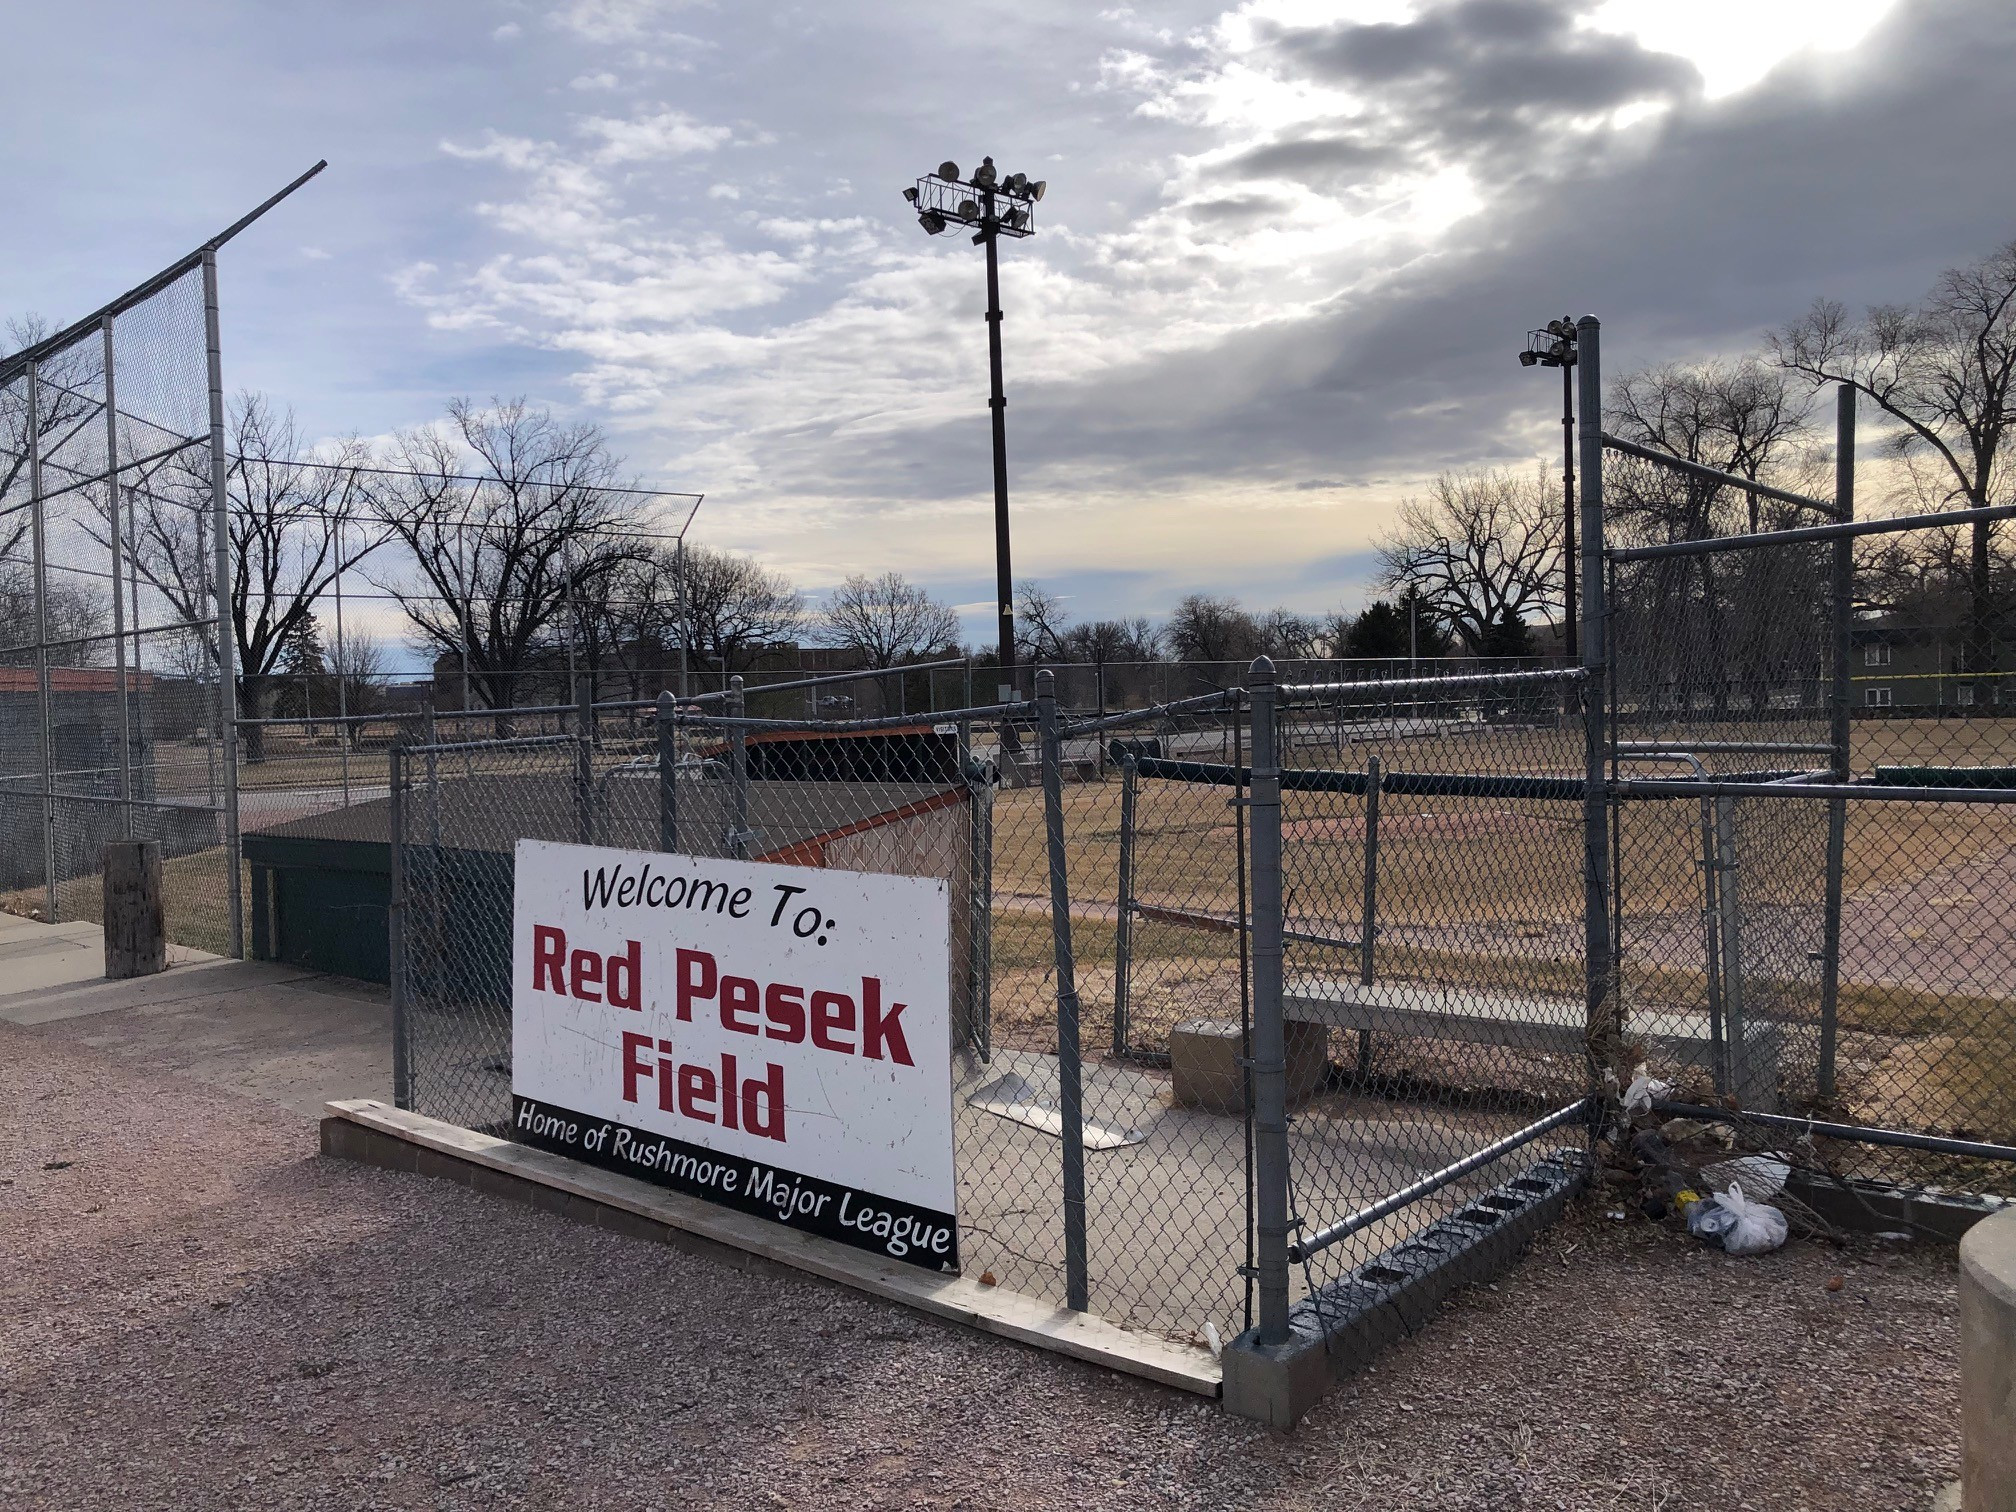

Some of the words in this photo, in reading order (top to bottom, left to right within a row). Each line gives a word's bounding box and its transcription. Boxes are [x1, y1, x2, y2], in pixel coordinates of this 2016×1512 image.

[583, 863, 752, 919] Welcome
[770, 884, 836, 946] To:
[532, 924, 643, 1012] Red
[675, 947, 916, 1067] Pesek
[622, 1030, 787, 1143] Field
[517, 1101, 578, 1144] Home
[584, 1124, 612, 1152] of
[613, 1128, 738, 1192] Rushmore
[744, 1166, 831, 1220] Major
[838, 1192, 950, 1256] League
